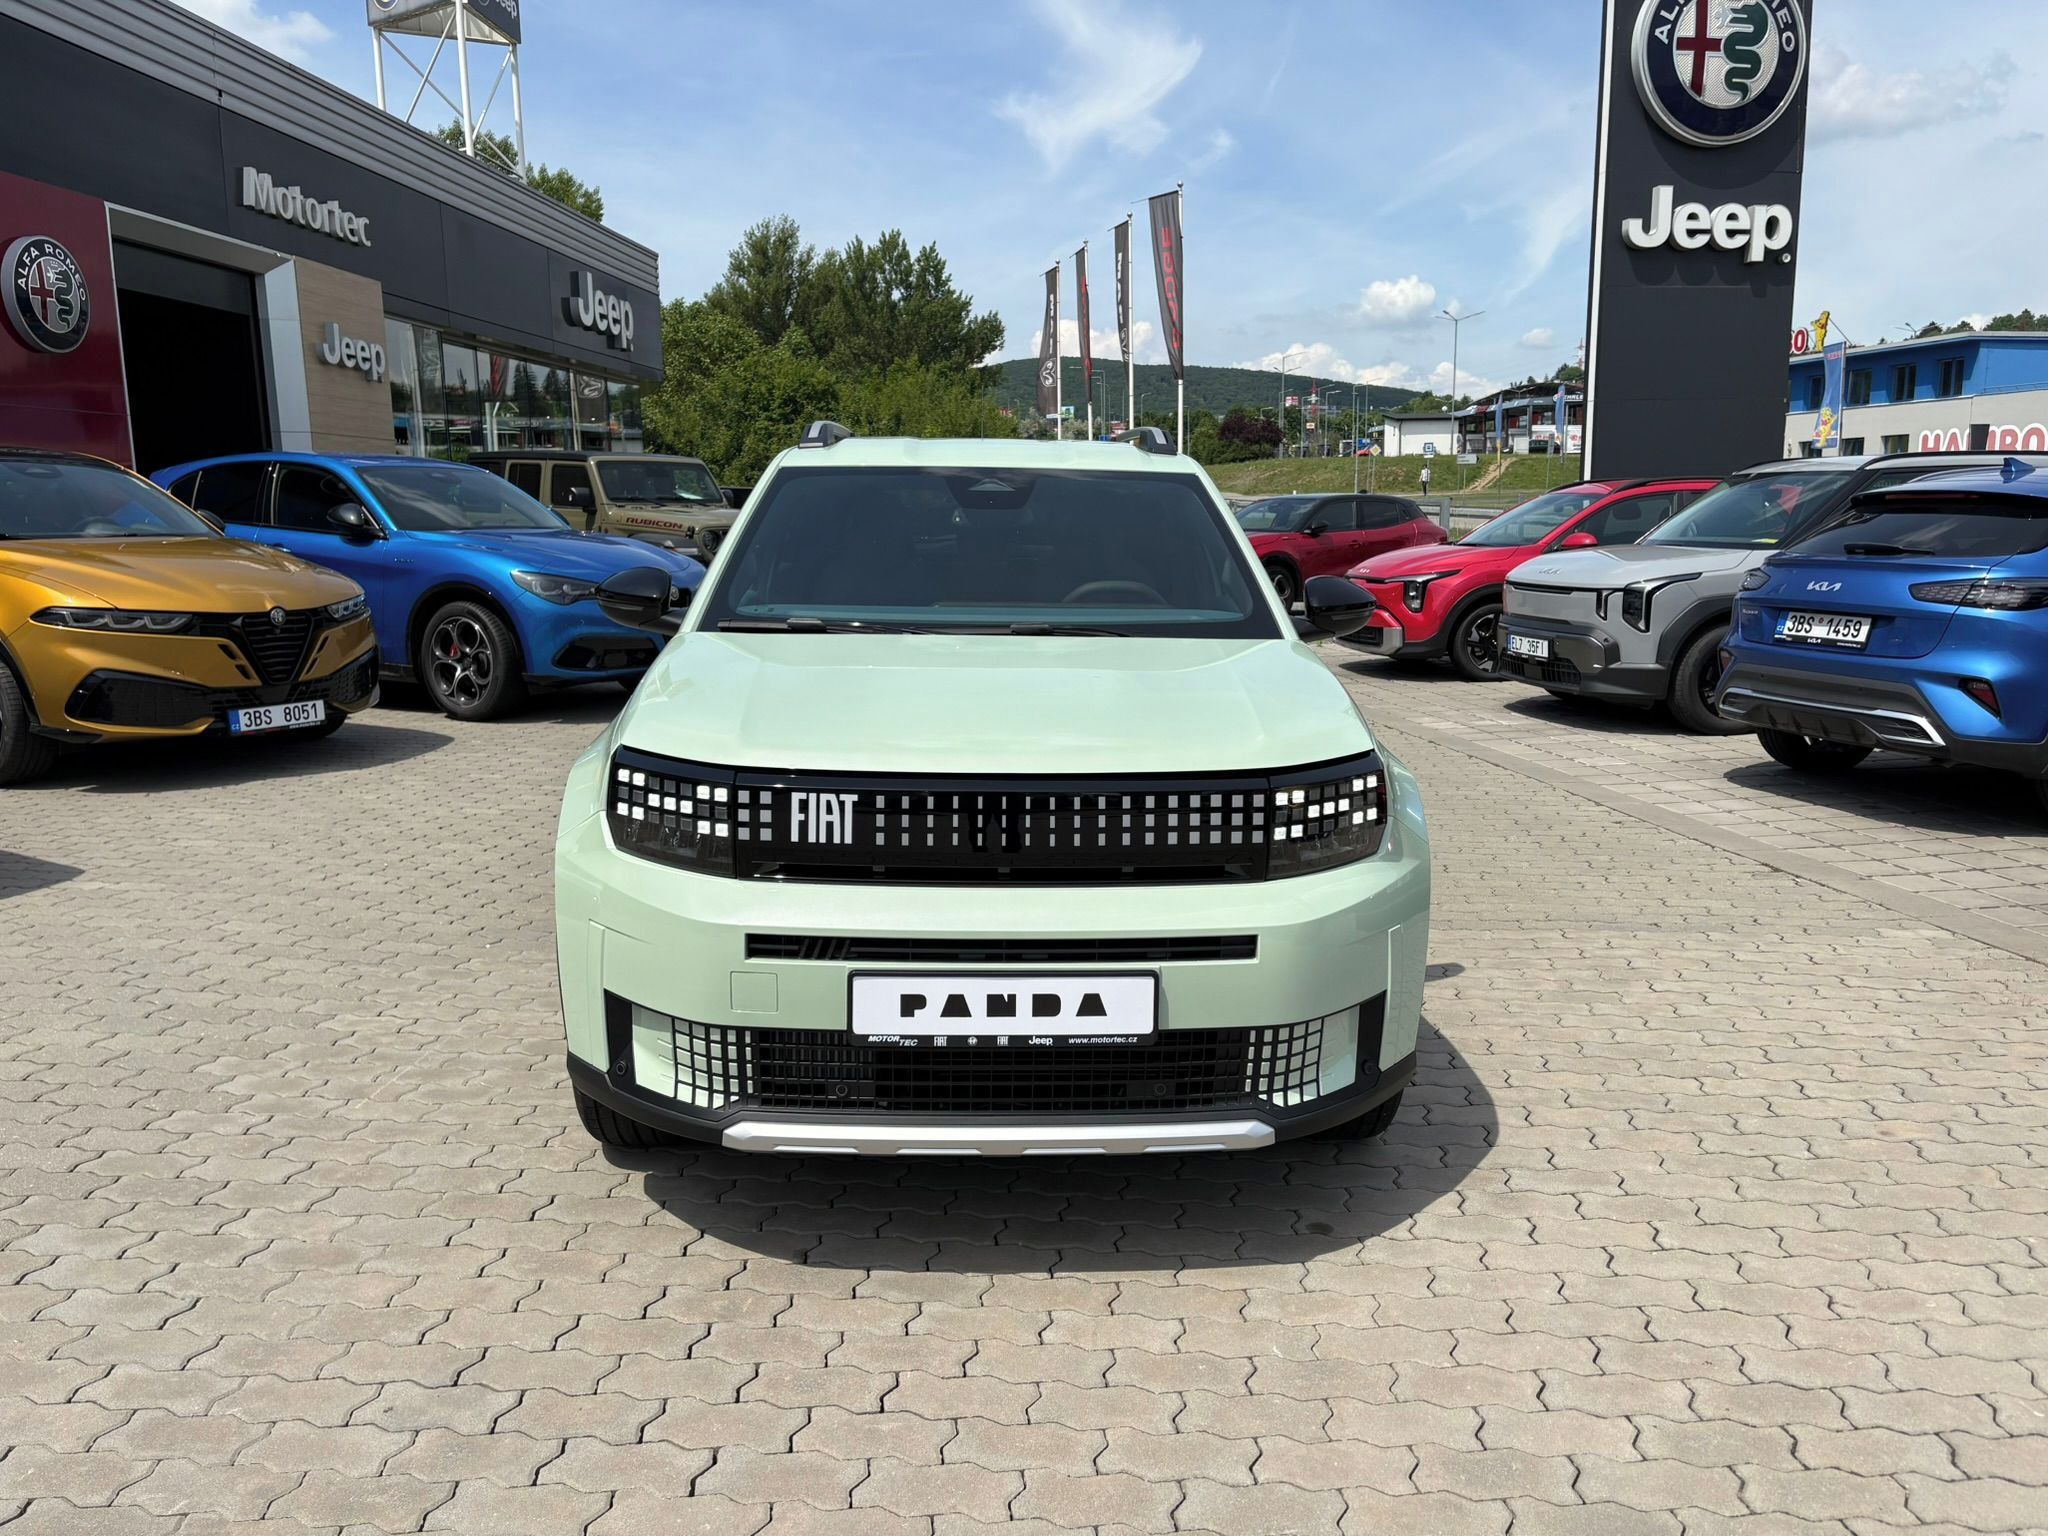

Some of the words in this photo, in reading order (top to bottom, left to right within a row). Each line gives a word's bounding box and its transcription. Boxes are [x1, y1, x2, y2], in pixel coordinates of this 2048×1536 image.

[243, 166, 371, 247] Motortec
[1622, 185, 1793, 263] Jeep
[18, 246, 40, 290] ALFA
[44, 243, 86, 301] ROMEO
[571, 271, 634, 350] Jeep
[320, 322, 386, 381] Jeep
[625, 516, 683, 530] RUBICON
[1806, 580, 1843, 592] KIA
[1787, 614, 1816, 634] 3BS
[1826, 617, 1863, 639] 1459
[243, 709, 273, 728] 3BS
[283, 702, 318, 723] 8051
[791, 791, 858, 844] FIAT
[900, 993, 1108, 1018] PANDA
[933, 1036, 948, 1047] FIAT
[1028, 1035, 1053, 1046] Jeep
[1068, 1036, 1138, 1044] www.motortec.cz
